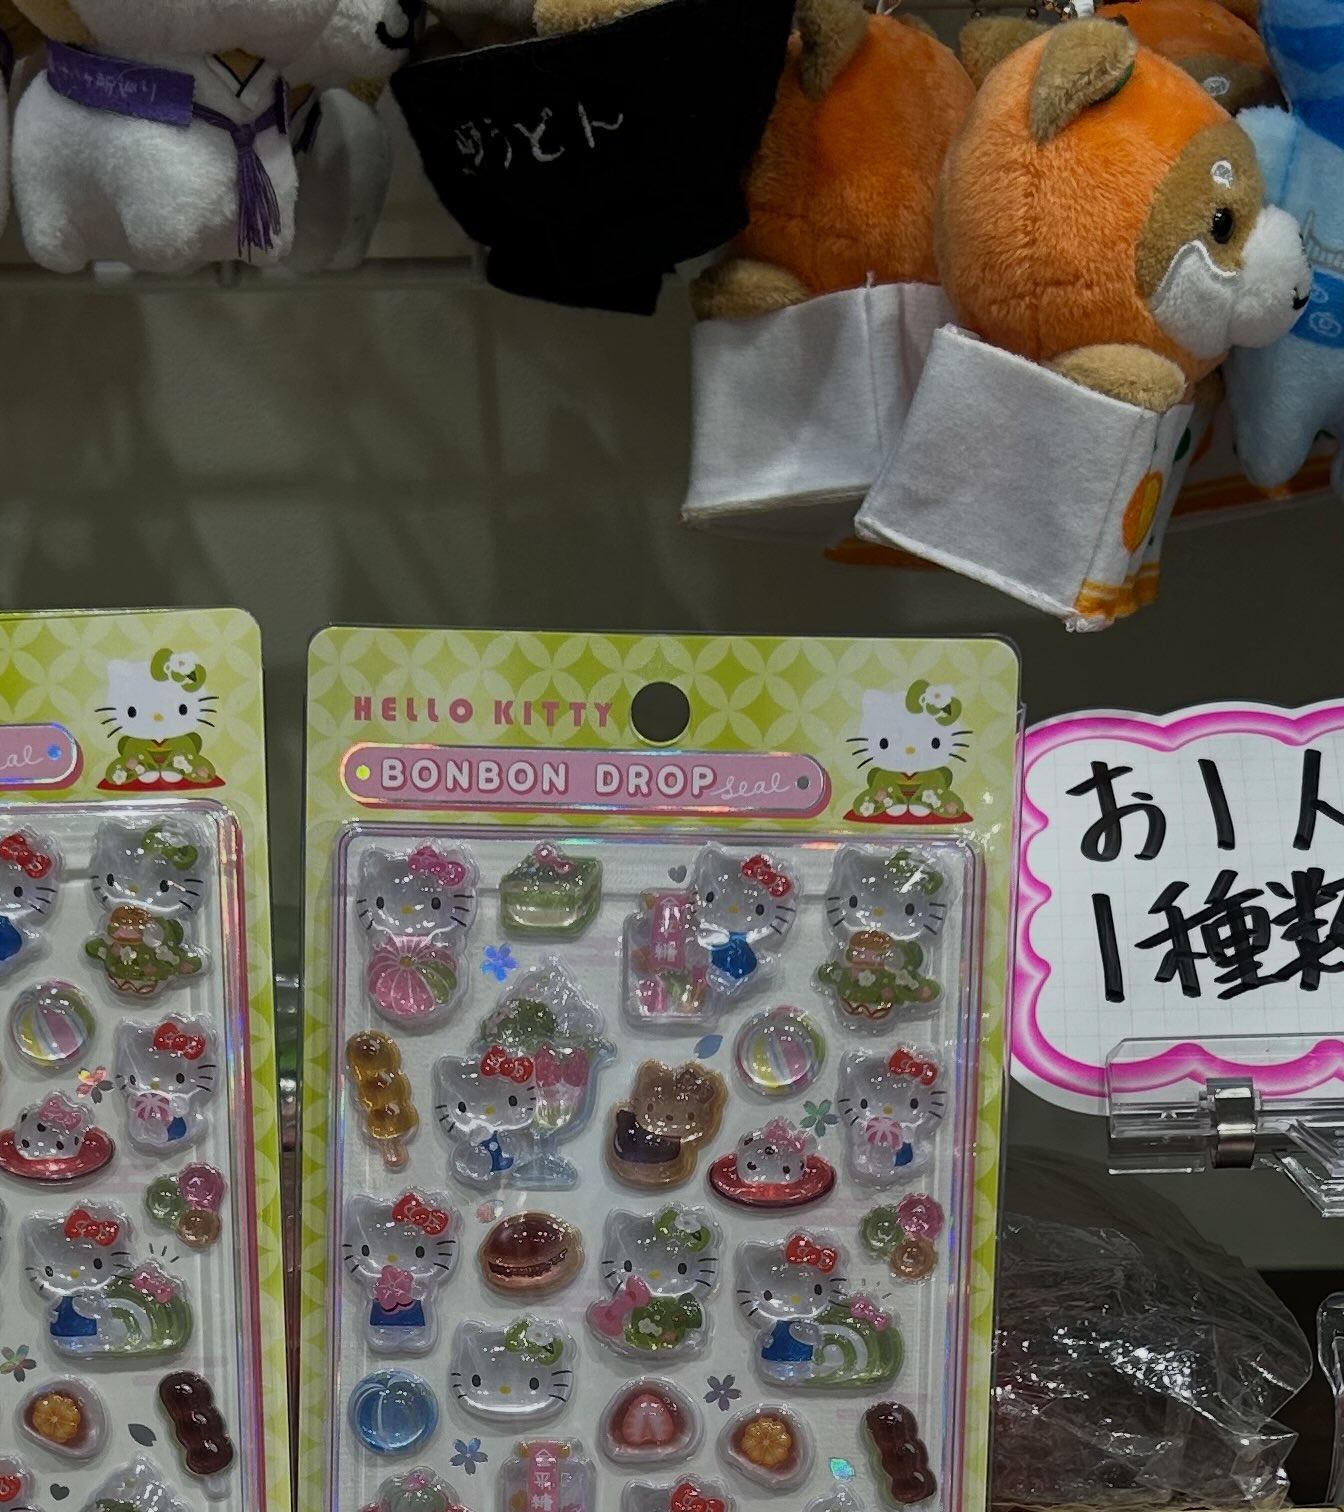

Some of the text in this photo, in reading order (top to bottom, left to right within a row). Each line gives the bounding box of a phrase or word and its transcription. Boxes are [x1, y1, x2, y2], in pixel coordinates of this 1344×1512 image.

[352, 695, 616, 728] HELLO KITTY
[380, 757, 569, 796] BONBON
[593, 761, 718, 799] DROP
